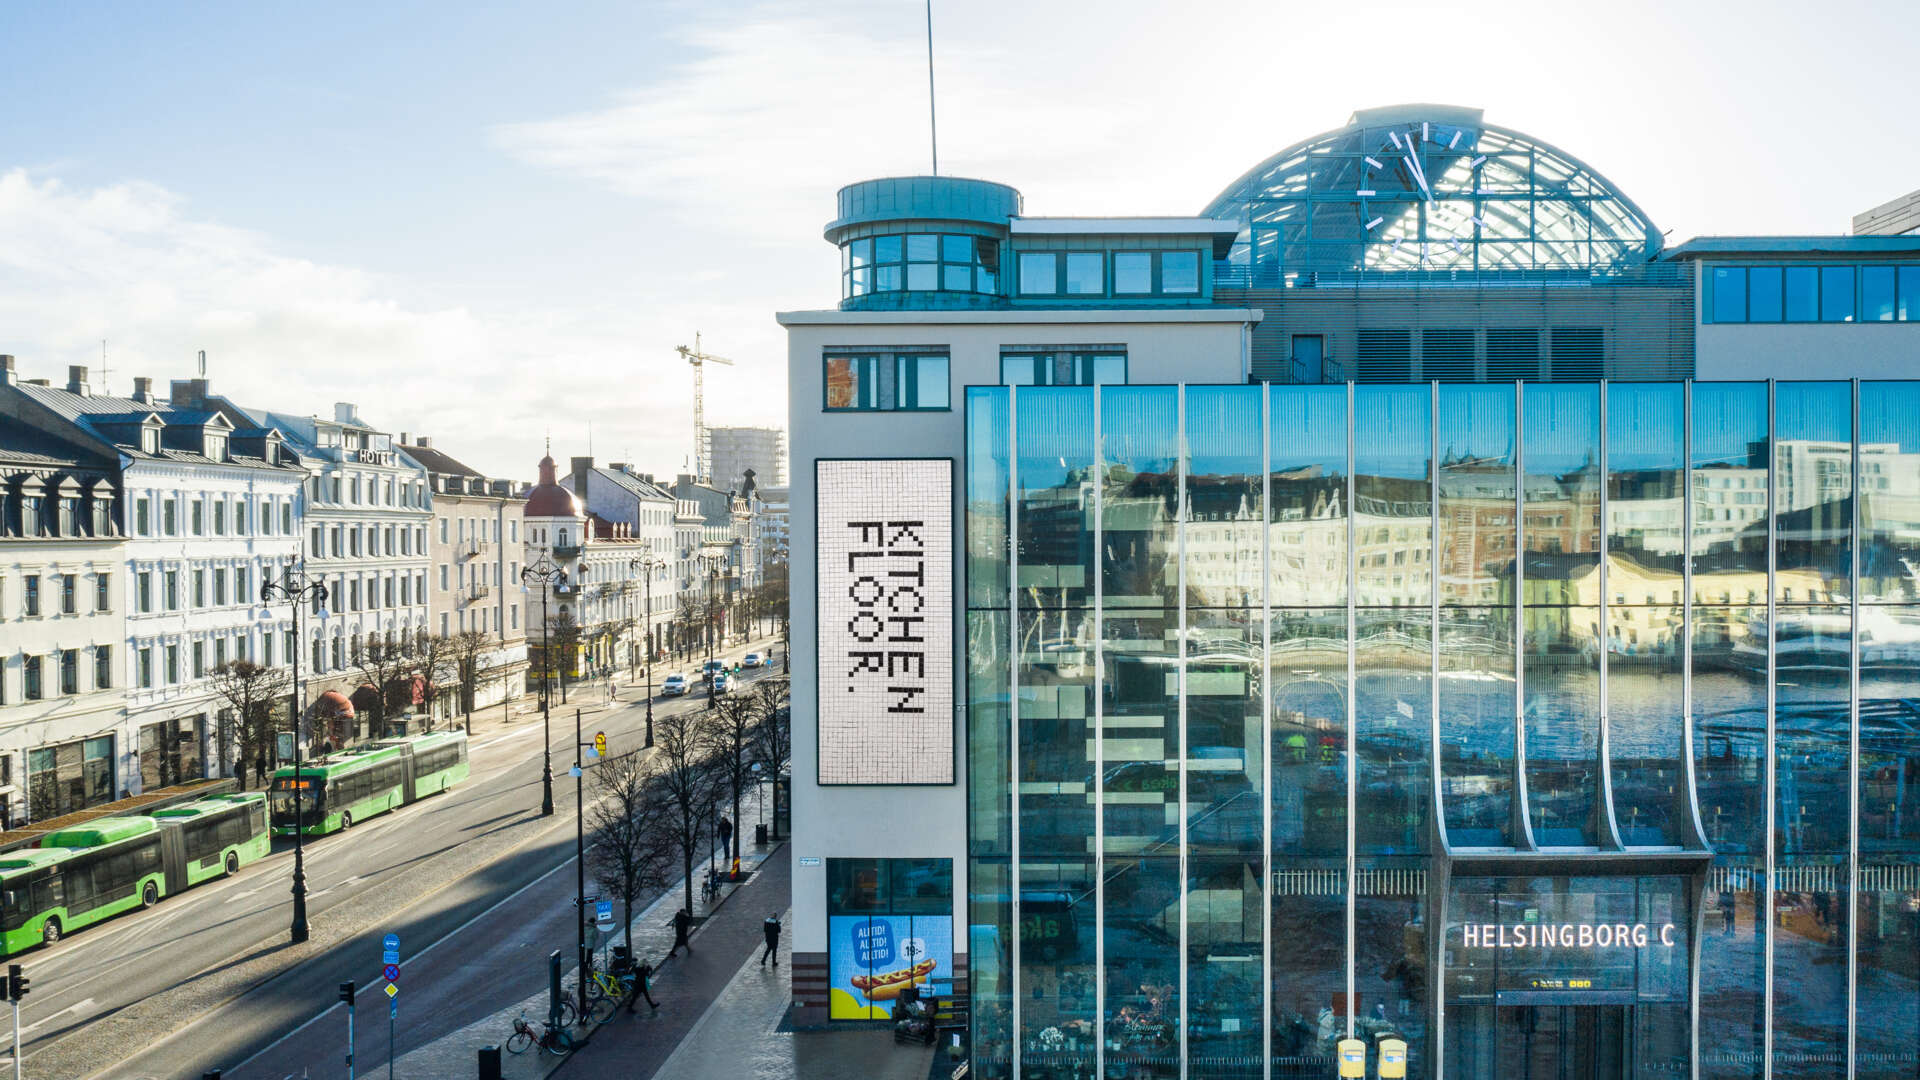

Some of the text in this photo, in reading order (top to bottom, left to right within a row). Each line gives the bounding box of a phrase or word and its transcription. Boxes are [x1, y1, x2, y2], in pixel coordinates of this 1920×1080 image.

[360, 449, 393, 467] HOTEL
[848, 521, 884, 692] FLOOR.
[888, 521, 924, 713] KITCHEN
[860, 937, 887, 949] ALTID!
[1464, 924, 1676, 948] HELSINGBORG C
